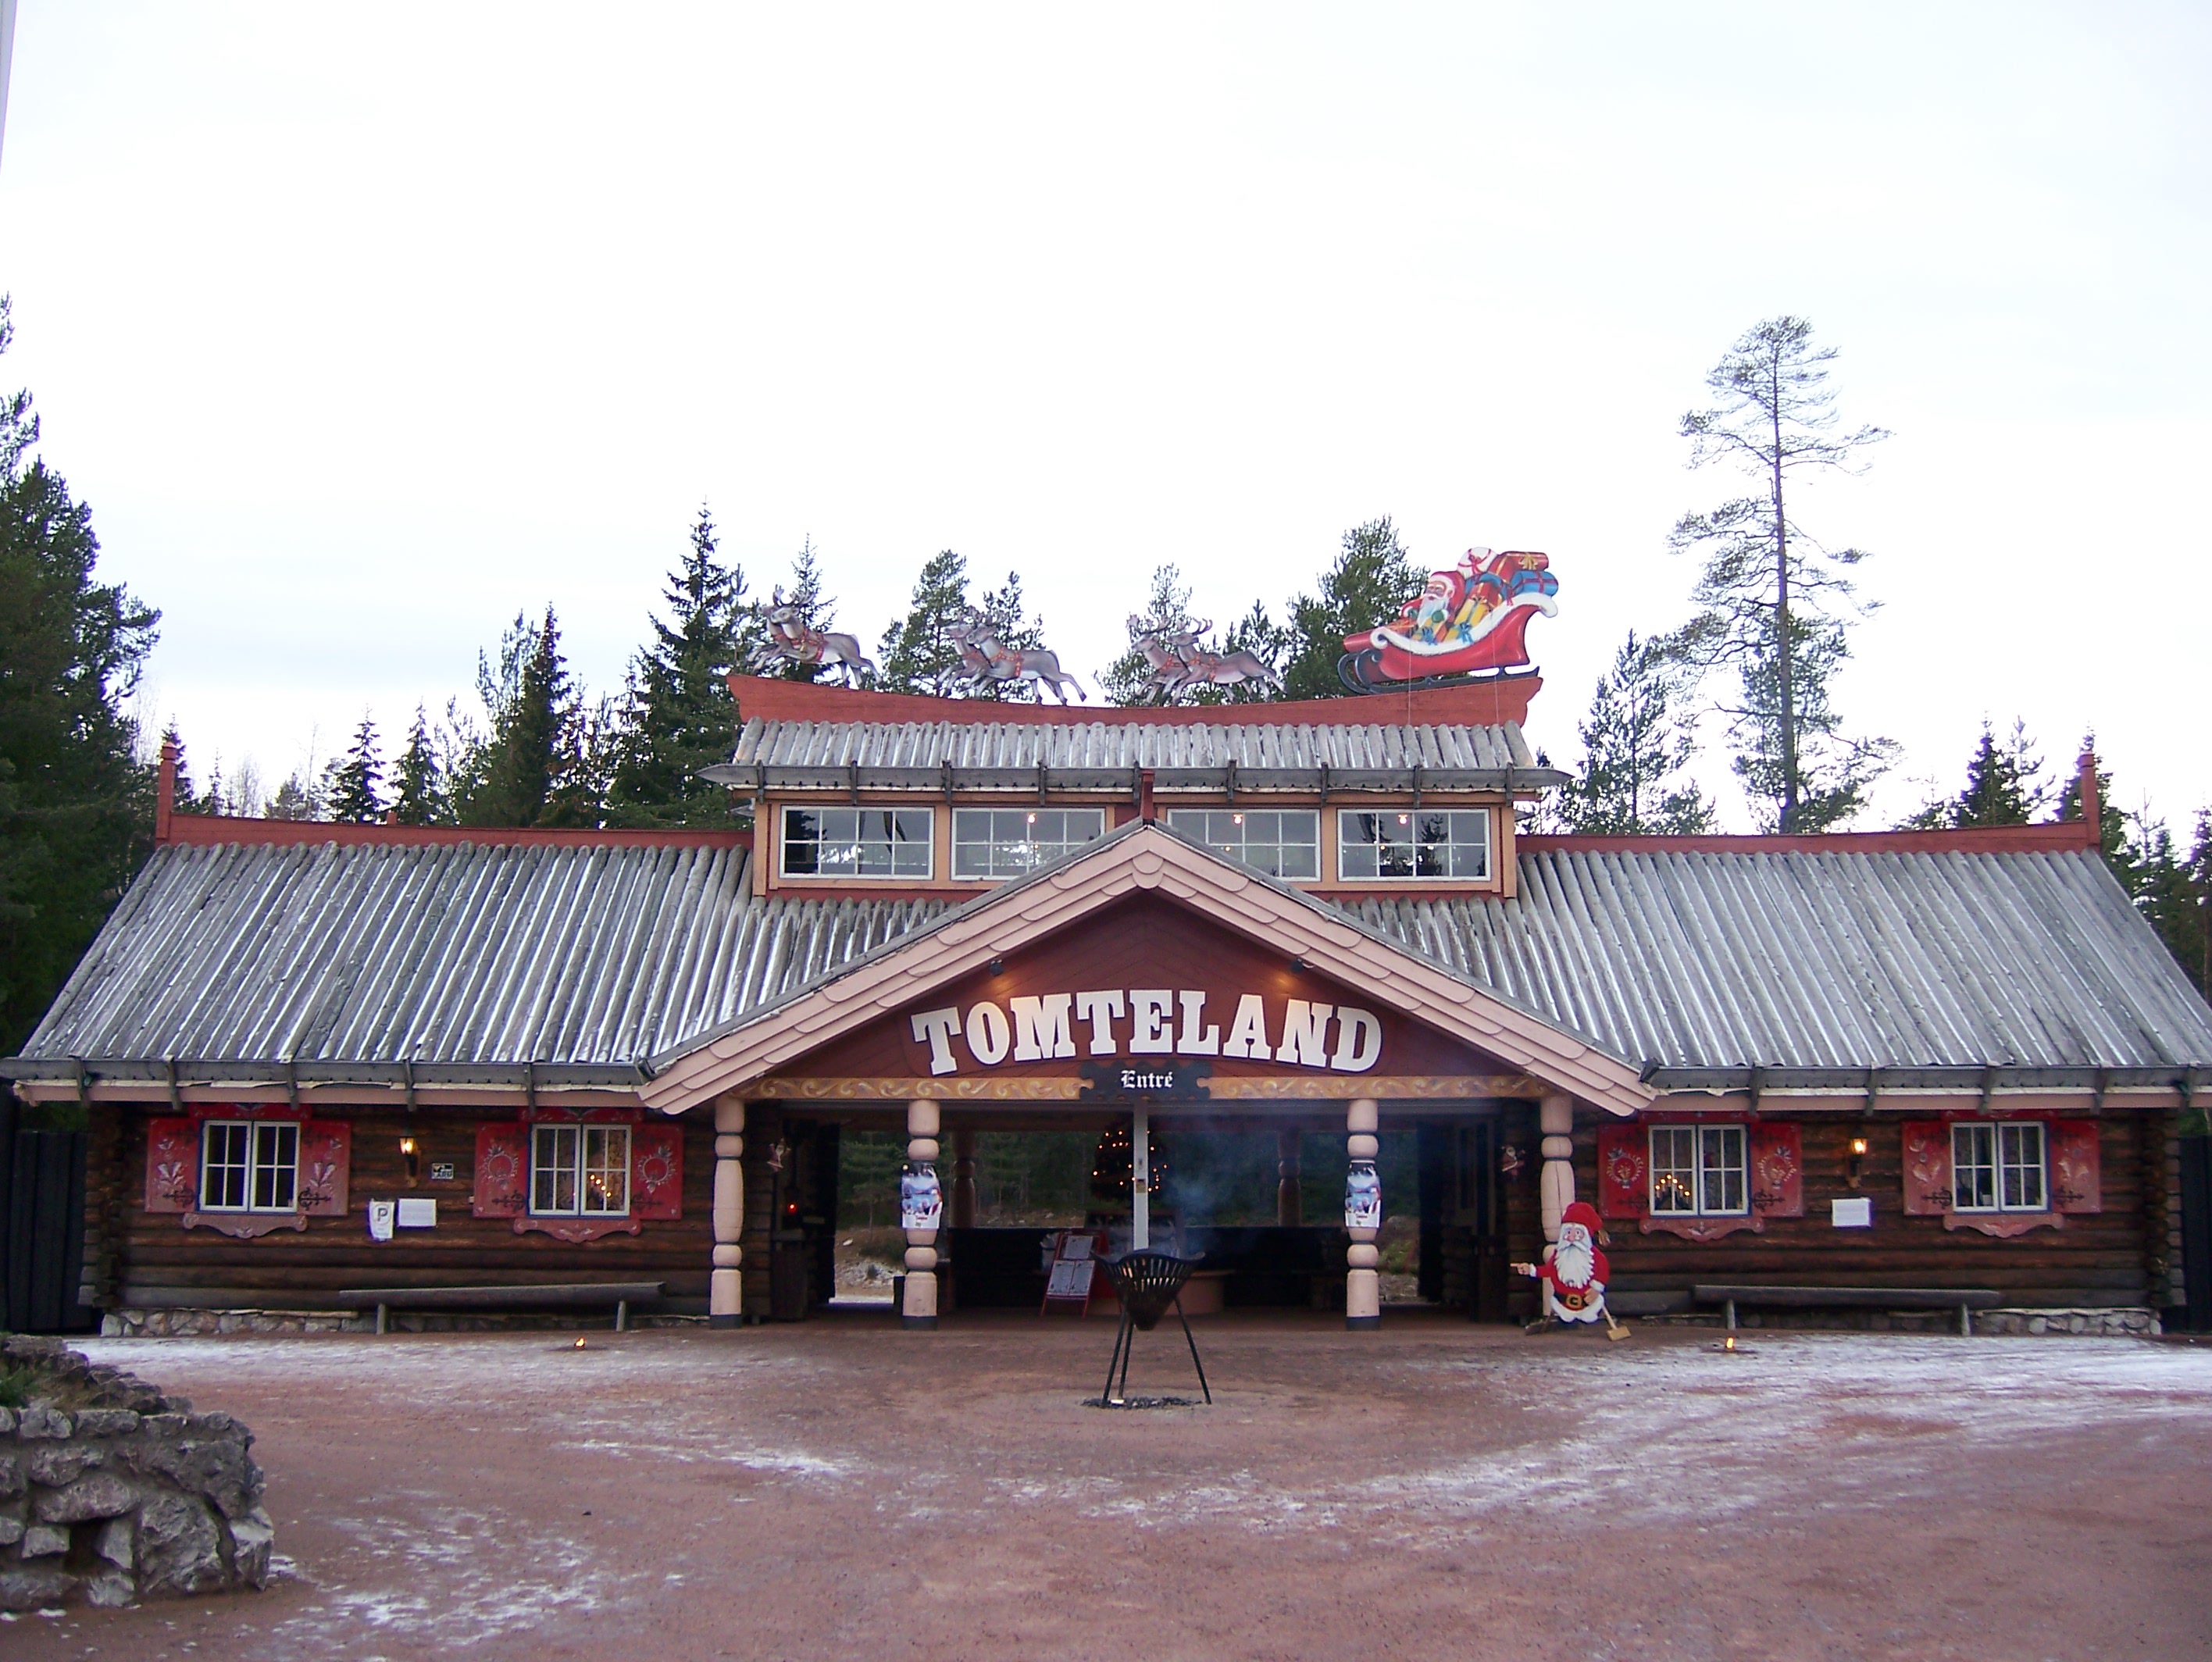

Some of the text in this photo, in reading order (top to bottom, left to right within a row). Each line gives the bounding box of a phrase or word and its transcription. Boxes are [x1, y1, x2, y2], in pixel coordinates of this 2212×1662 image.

[912, 990, 1382, 1075] TOMTELAND
[1121, 1069, 1173, 1089] Entré
[377, 1207, 388, 1222] P
